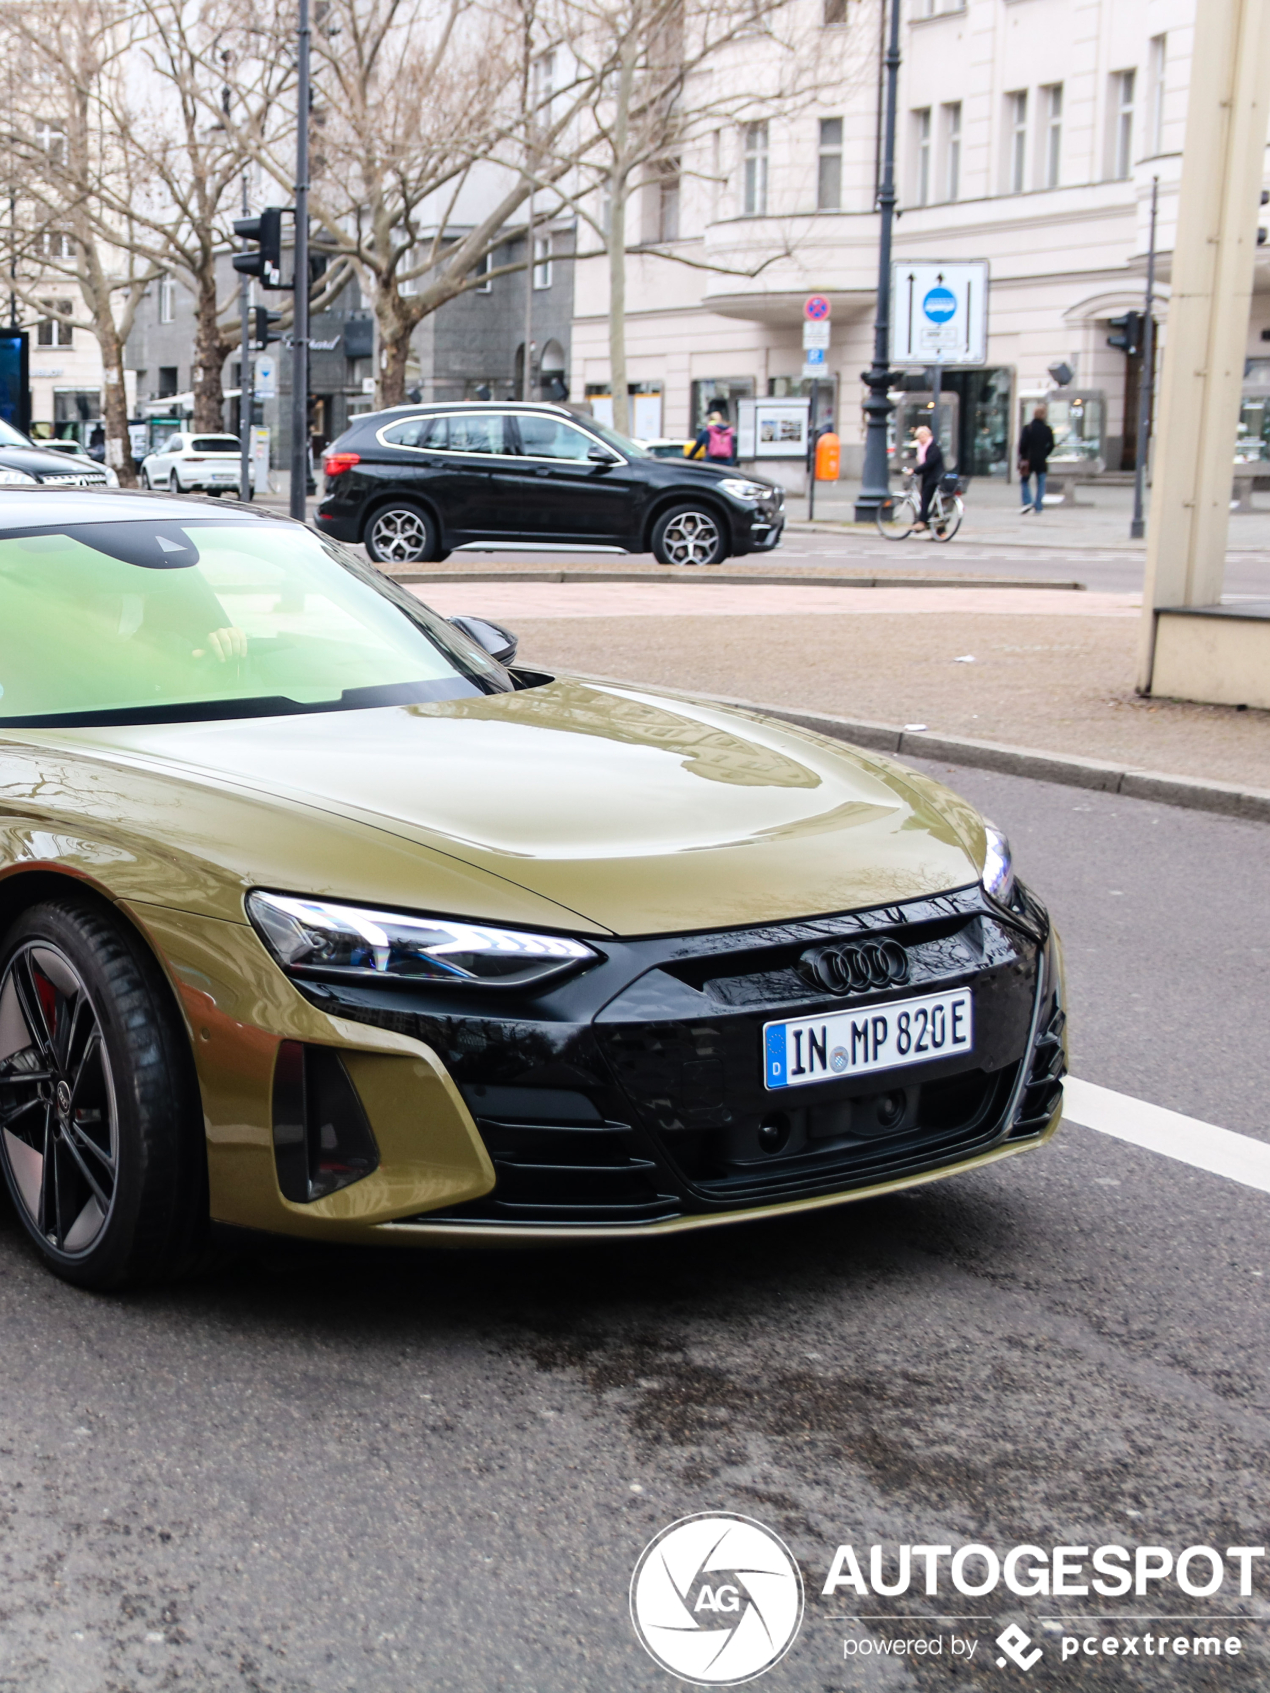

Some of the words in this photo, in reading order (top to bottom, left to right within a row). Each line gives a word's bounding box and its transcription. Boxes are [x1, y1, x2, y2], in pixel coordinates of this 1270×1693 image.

[790, 1024, 828, 1076] IN
[850, 1014, 889, 1066] MP
[772, 1061, 782, 1076] D
